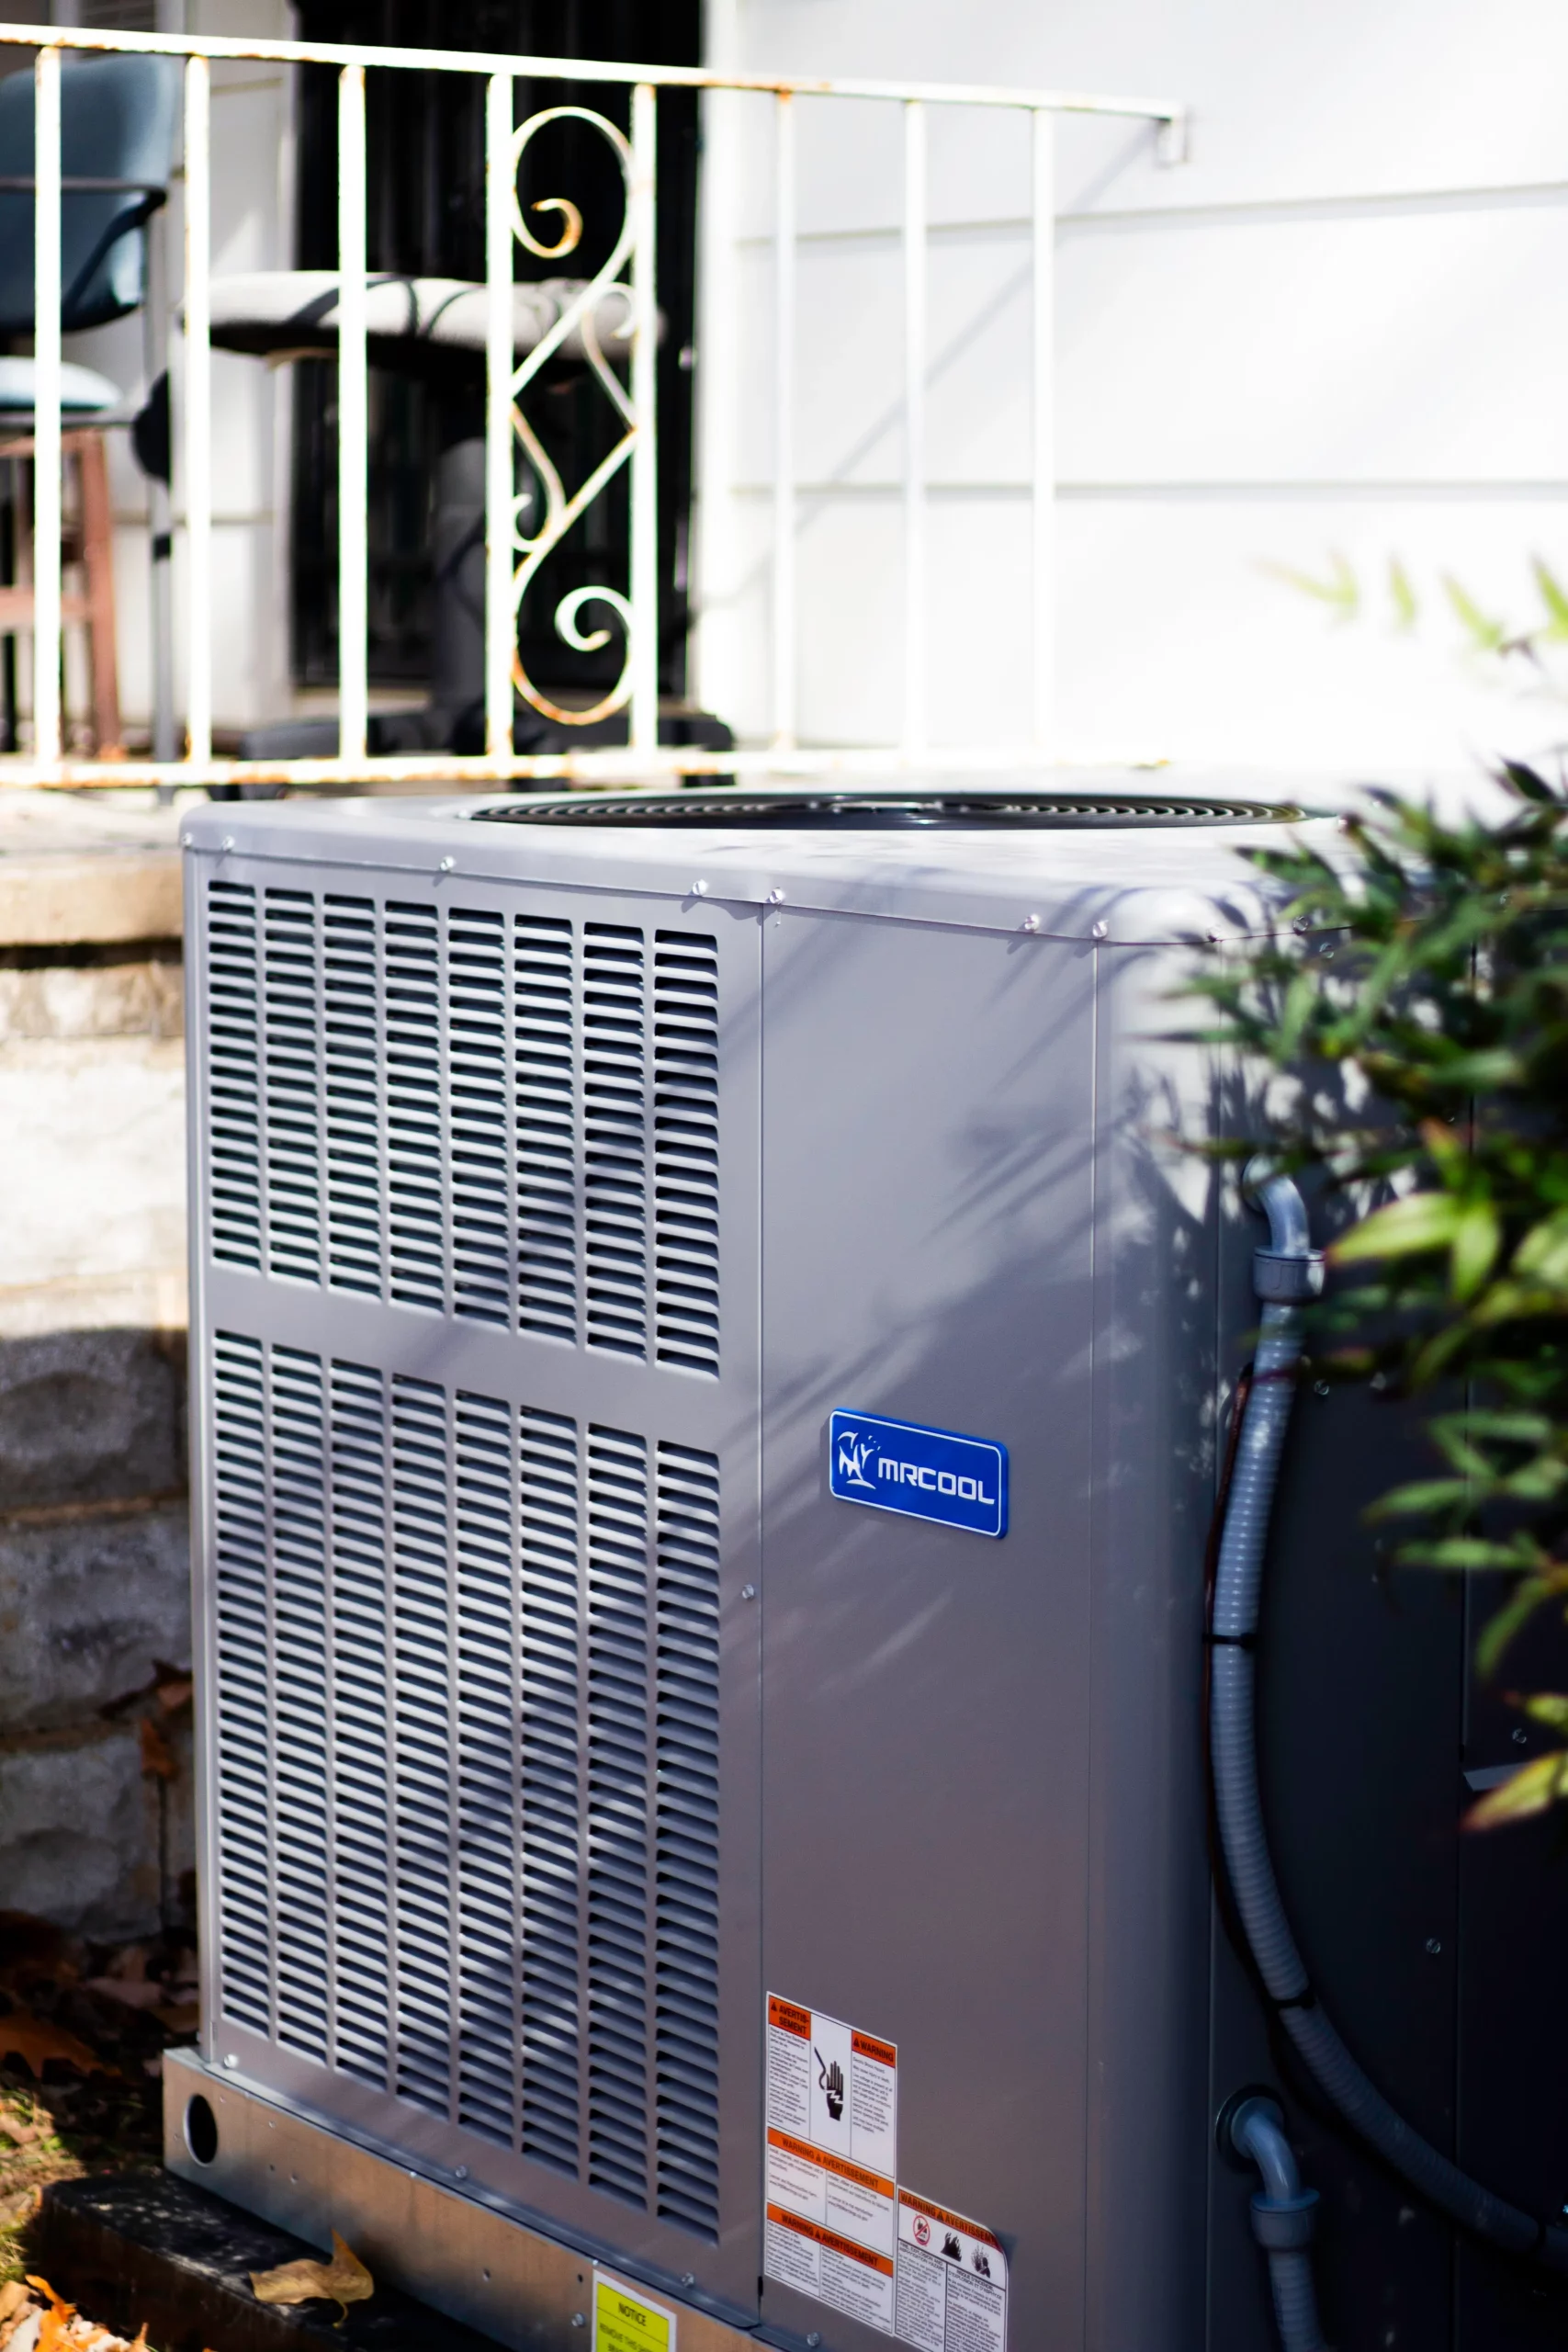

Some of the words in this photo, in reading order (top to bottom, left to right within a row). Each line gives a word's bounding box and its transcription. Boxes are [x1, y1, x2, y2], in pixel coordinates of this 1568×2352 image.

[878, 1457, 995, 1505] MRCOOL
[779, 2005, 809, 2023] AVERTIS-
[779, 2016, 806, 2035] SEMENT
[861, 2040, 893, 2063] WARNING
[782, 2137, 814, 2159] WARNING
[823, 2155, 879, 2188] AVERTISSEMENT
[901, 2192, 936, 2217] WARNING
[781, 2213, 814, 2235] WARNING
[823, 2233, 878, 2267] AVERTISSEMENT
[618, 2302, 647, 2327] NOTICE
